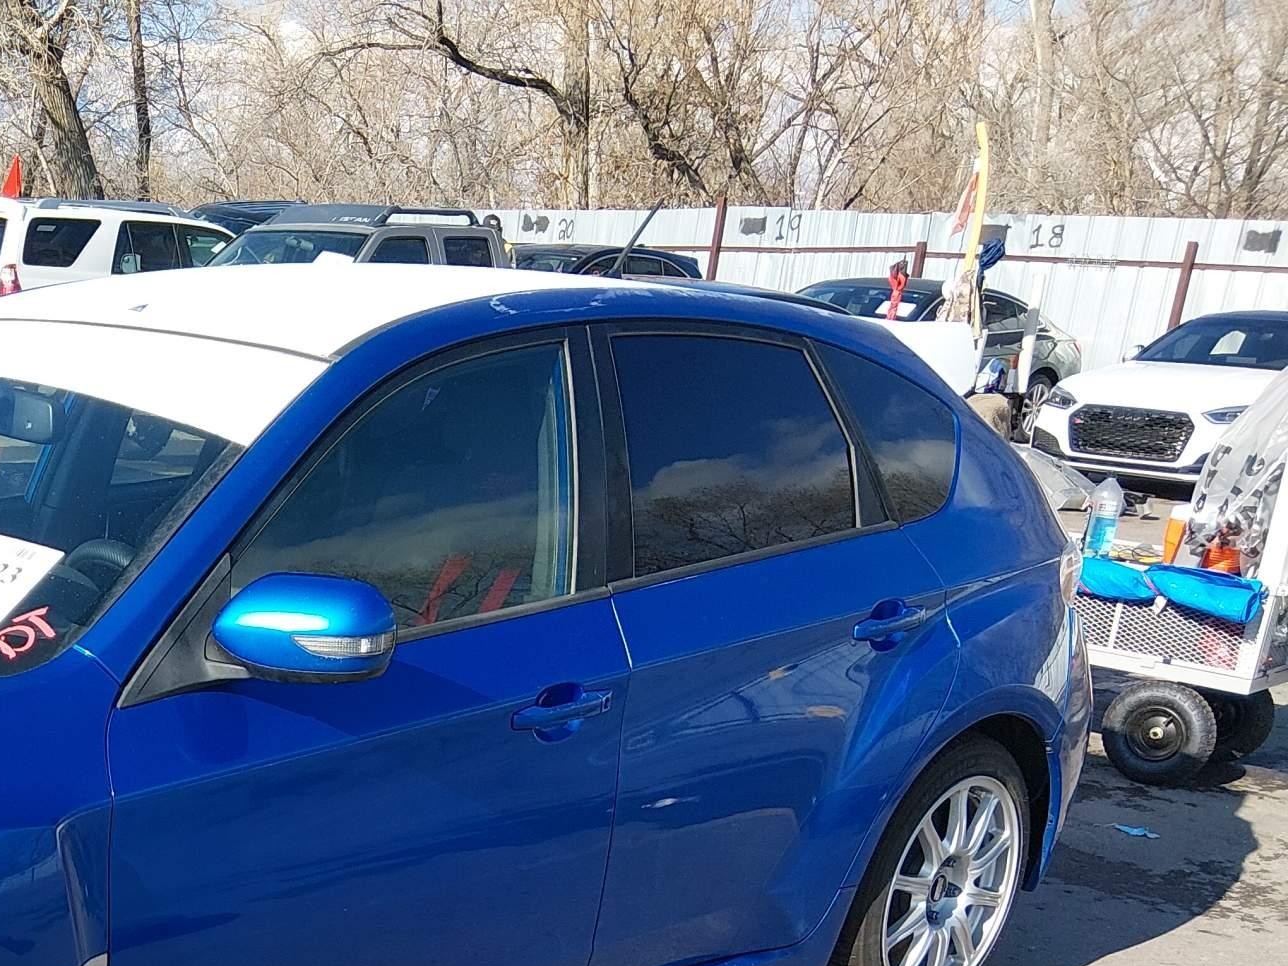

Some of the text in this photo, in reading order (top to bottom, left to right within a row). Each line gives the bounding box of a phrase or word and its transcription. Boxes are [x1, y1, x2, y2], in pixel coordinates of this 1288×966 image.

[557, 217, 576, 241] 20
[774, 212, 803, 243] 19
[1029, 223, 1066, 250] 18
